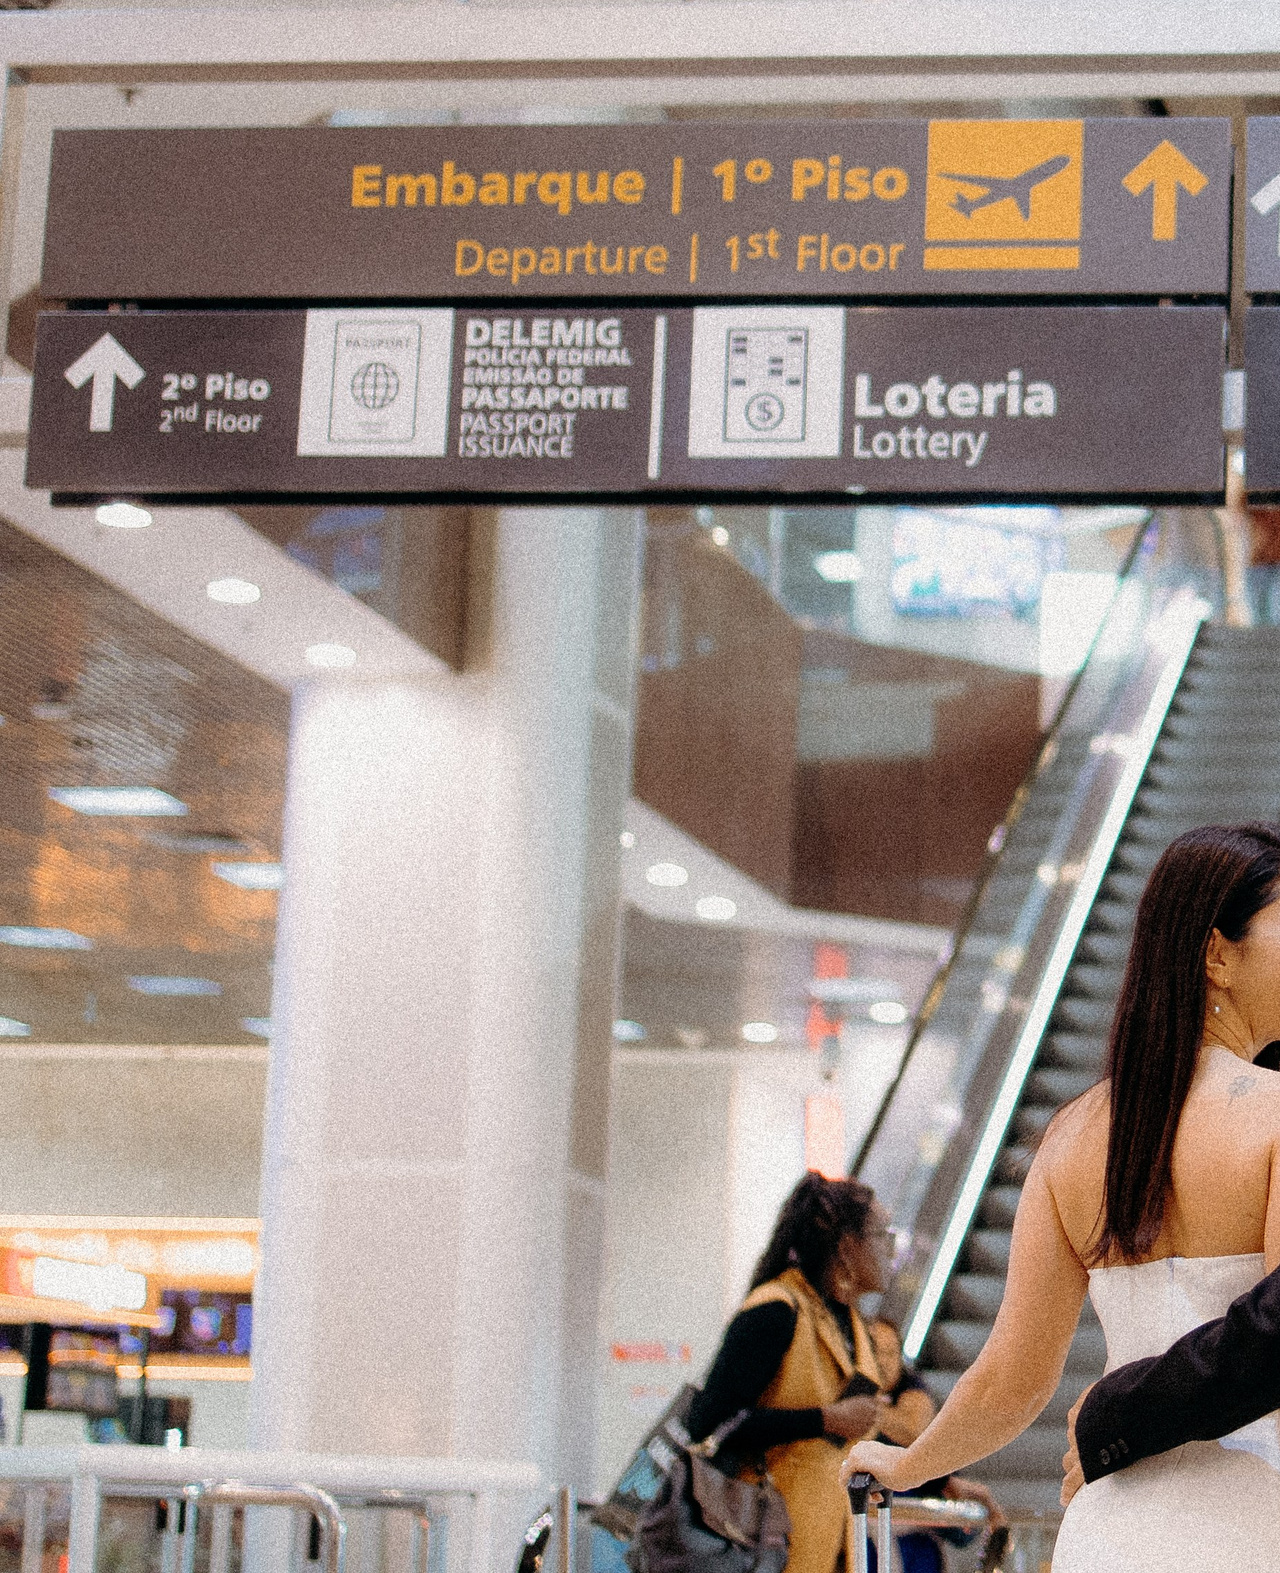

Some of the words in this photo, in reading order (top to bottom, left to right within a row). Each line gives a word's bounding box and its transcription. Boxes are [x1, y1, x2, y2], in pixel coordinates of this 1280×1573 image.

[351, 161, 646, 215] Embarque
[712, 158, 772, 201] 1º
[792, 155, 909, 201] Piso
[455, 239, 668, 284] Departure
[725, 227, 780, 272] 1st
[796, 233, 906, 272] Floor
[466, 318, 621, 347] DELEMIG
[205, 372, 270, 401] Piso
[556, 367, 585, 386] DE
[461, 386, 629, 410] PASSAPORTE
[854, 370, 1057, 418] Loteria
[159, 402, 198, 433] 2nd
[204, 409, 262, 433] Floor
[460, 412, 576, 435] PASSPORT
[458, 434, 573, 458] ISSUANCE
[853, 424, 988, 467] Lottery
